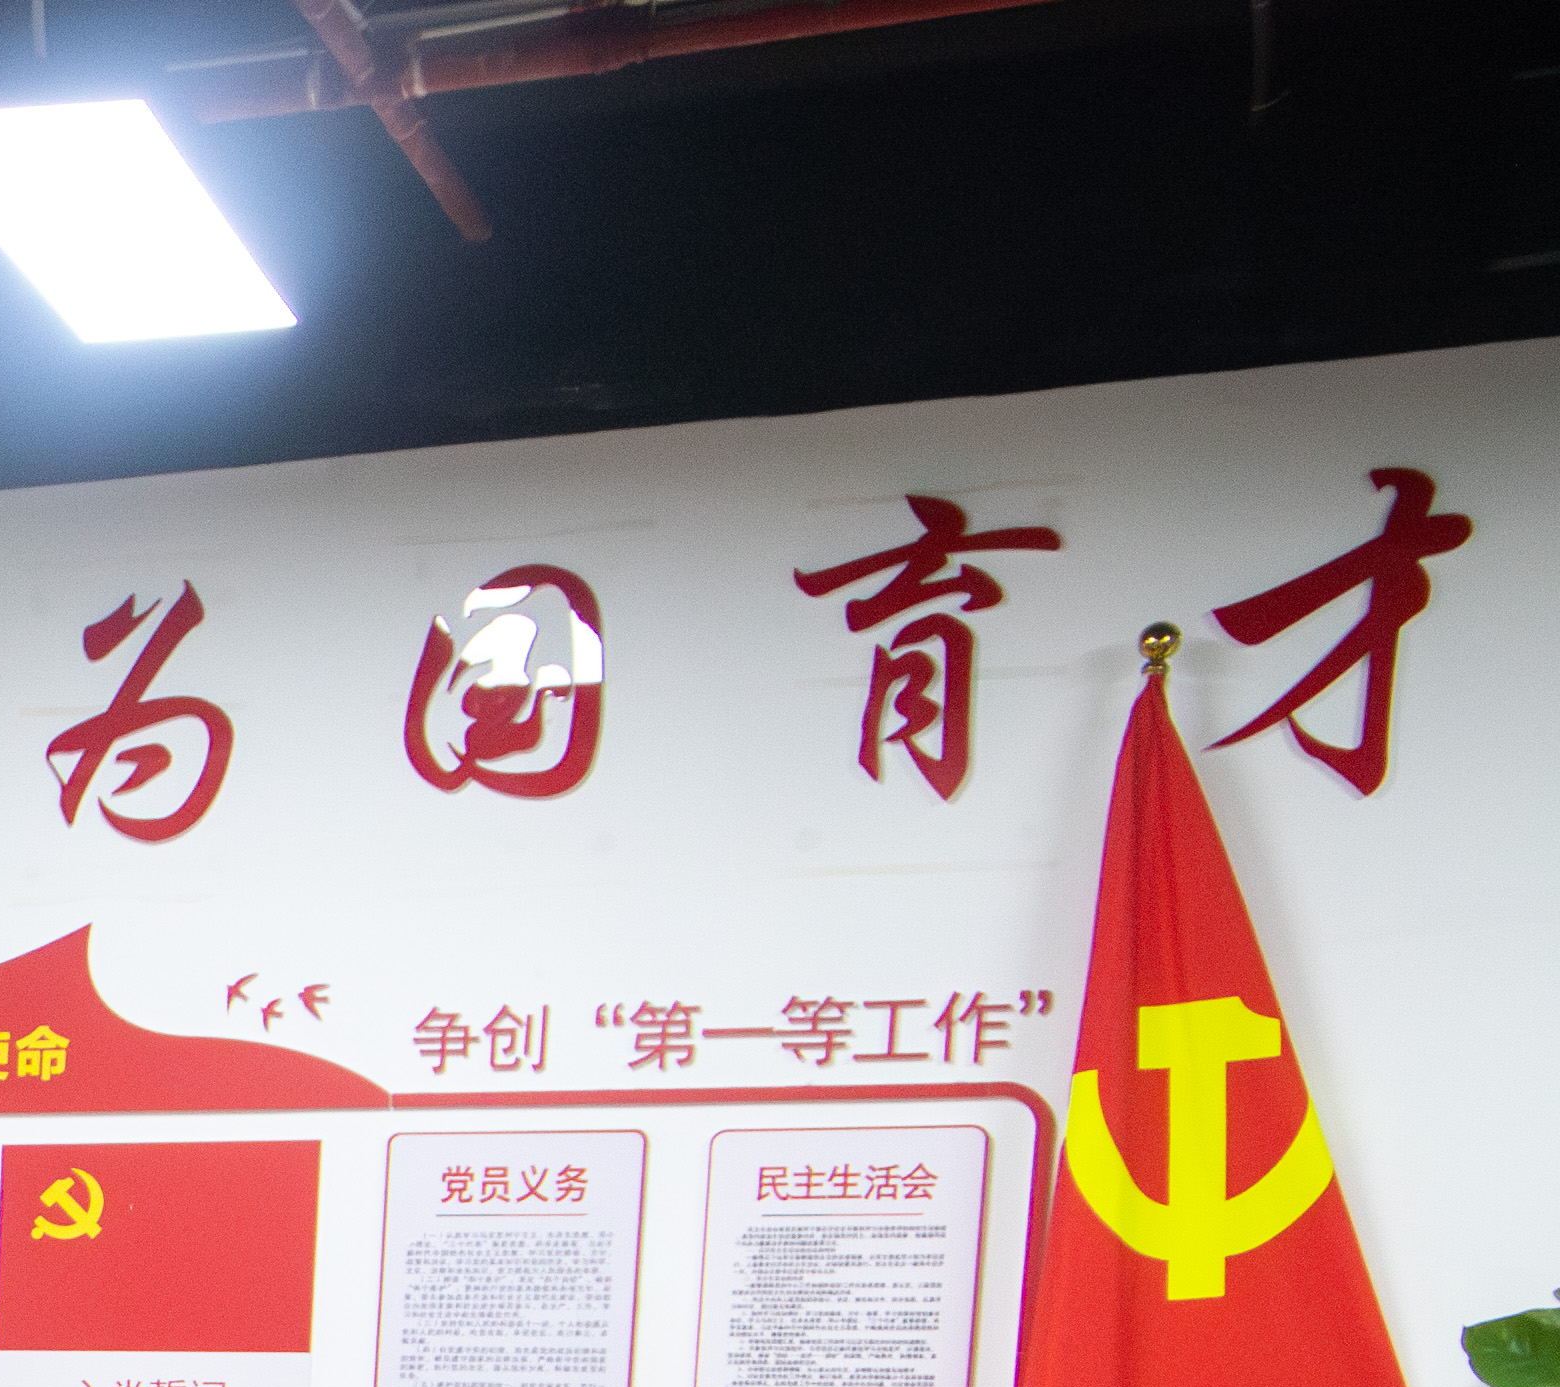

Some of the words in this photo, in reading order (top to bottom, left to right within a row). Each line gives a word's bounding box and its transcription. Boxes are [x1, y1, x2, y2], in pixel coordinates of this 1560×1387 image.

[413, 1004, 549, 1076] 争创
[441, 1164, 588, 1203] 党员义务
[756, 1162, 939, 1201] 民主生活会
